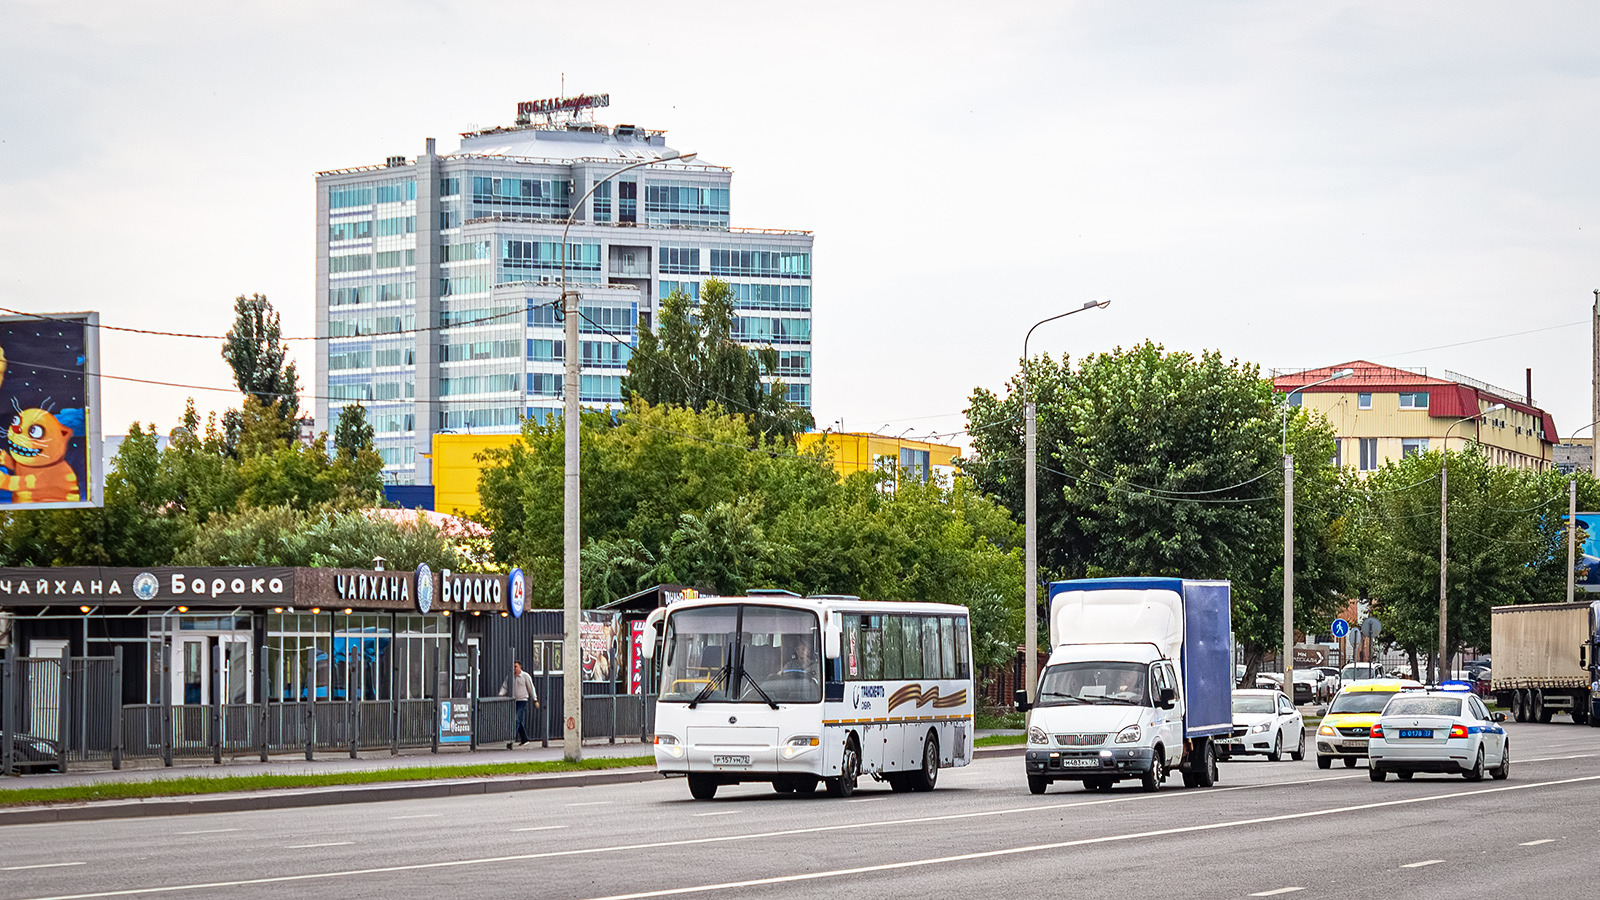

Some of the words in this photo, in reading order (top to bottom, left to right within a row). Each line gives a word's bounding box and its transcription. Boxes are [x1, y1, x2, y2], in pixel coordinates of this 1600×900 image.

[0, 579, 122, 595] ЧАЙХАНА
[171, 574, 284, 598] Барака
[336, 574, 409, 601] ЧАЙХАНА
[441, 569, 501, 611] Барака
[514, 581, 523, 598] 24
